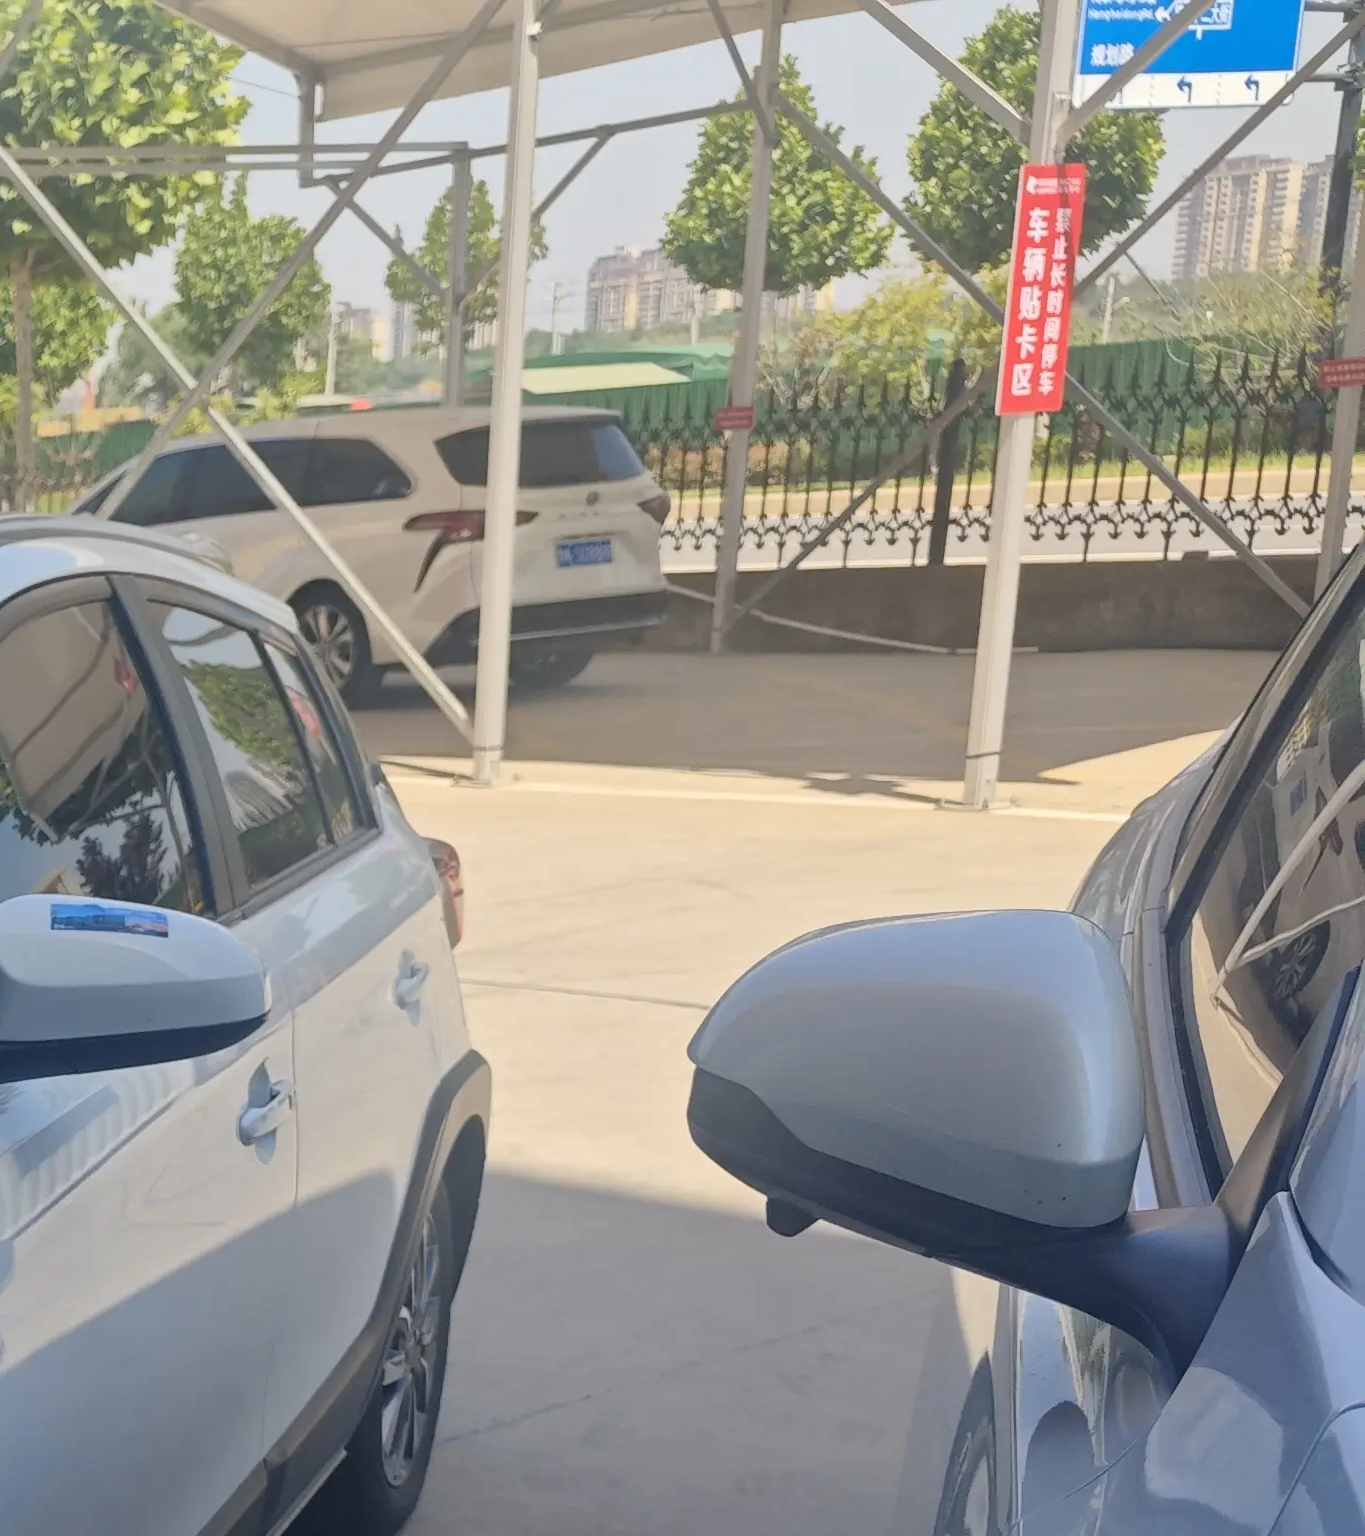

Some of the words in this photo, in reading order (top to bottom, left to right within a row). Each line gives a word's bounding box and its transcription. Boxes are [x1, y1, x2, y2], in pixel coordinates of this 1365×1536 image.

[1010, 206, 1050, 397] 车辆贴卡区
[1037, 207, 1073, 396] 禁止长时间停车
